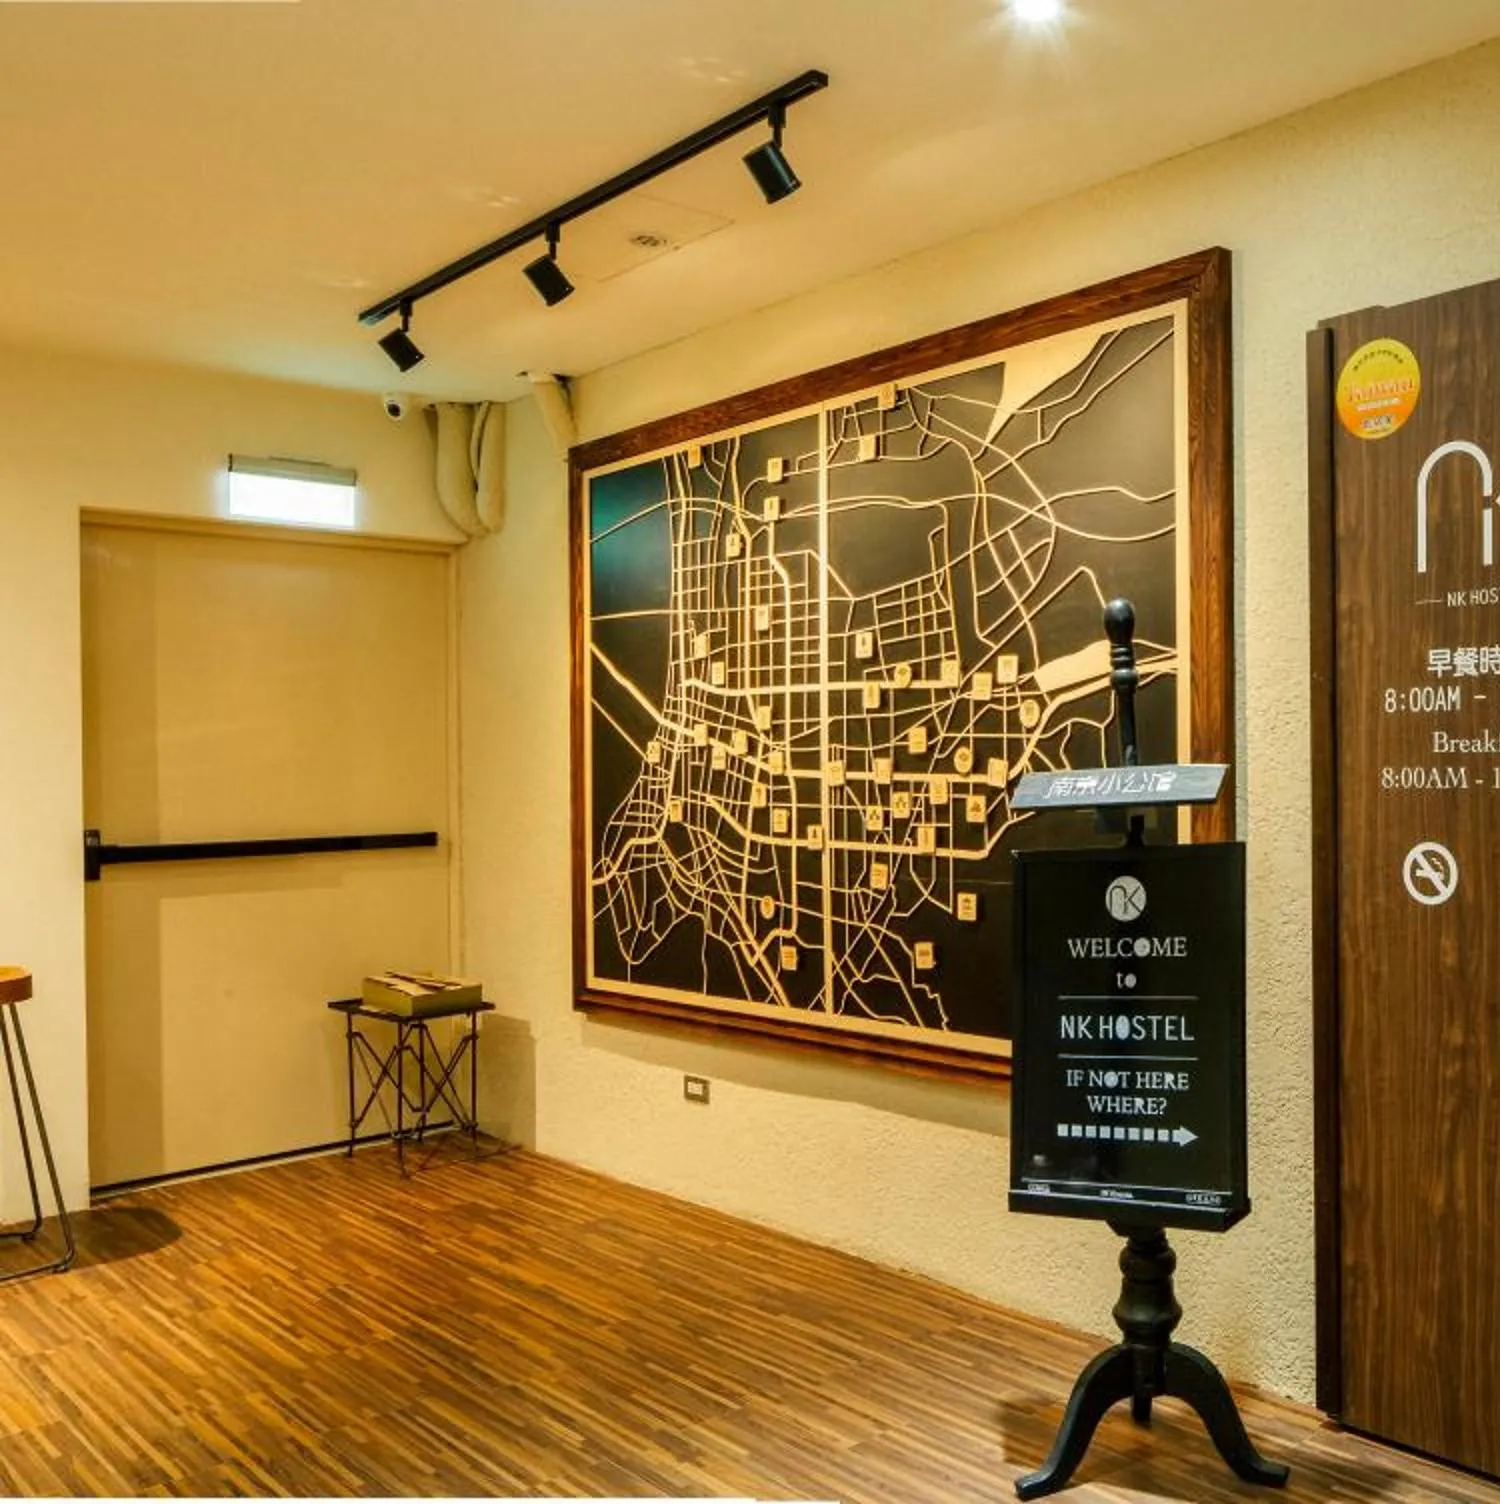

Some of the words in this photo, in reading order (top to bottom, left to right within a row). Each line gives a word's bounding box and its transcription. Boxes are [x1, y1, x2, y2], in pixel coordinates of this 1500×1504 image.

[1446, 591, 1468, 608] NK
[1384, 685, 1461, 713] 8:00AM
[1381, 766, 1468, 790] 8:00AM
[1067, 936, 1188, 958] WELCOME
[1116, 972, 1137, 989] to
[1060, 1014, 1094, 1040] NK
[1099, 1014, 1195, 1041] HOSTEL
[1066, 1069, 1085, 1088] IF
[1089, 1070, 1131, 1089] NOT
[1135, 1071, 1190, 1090] HERE
[1086, 1095, 1167, 1115] WHERE?
